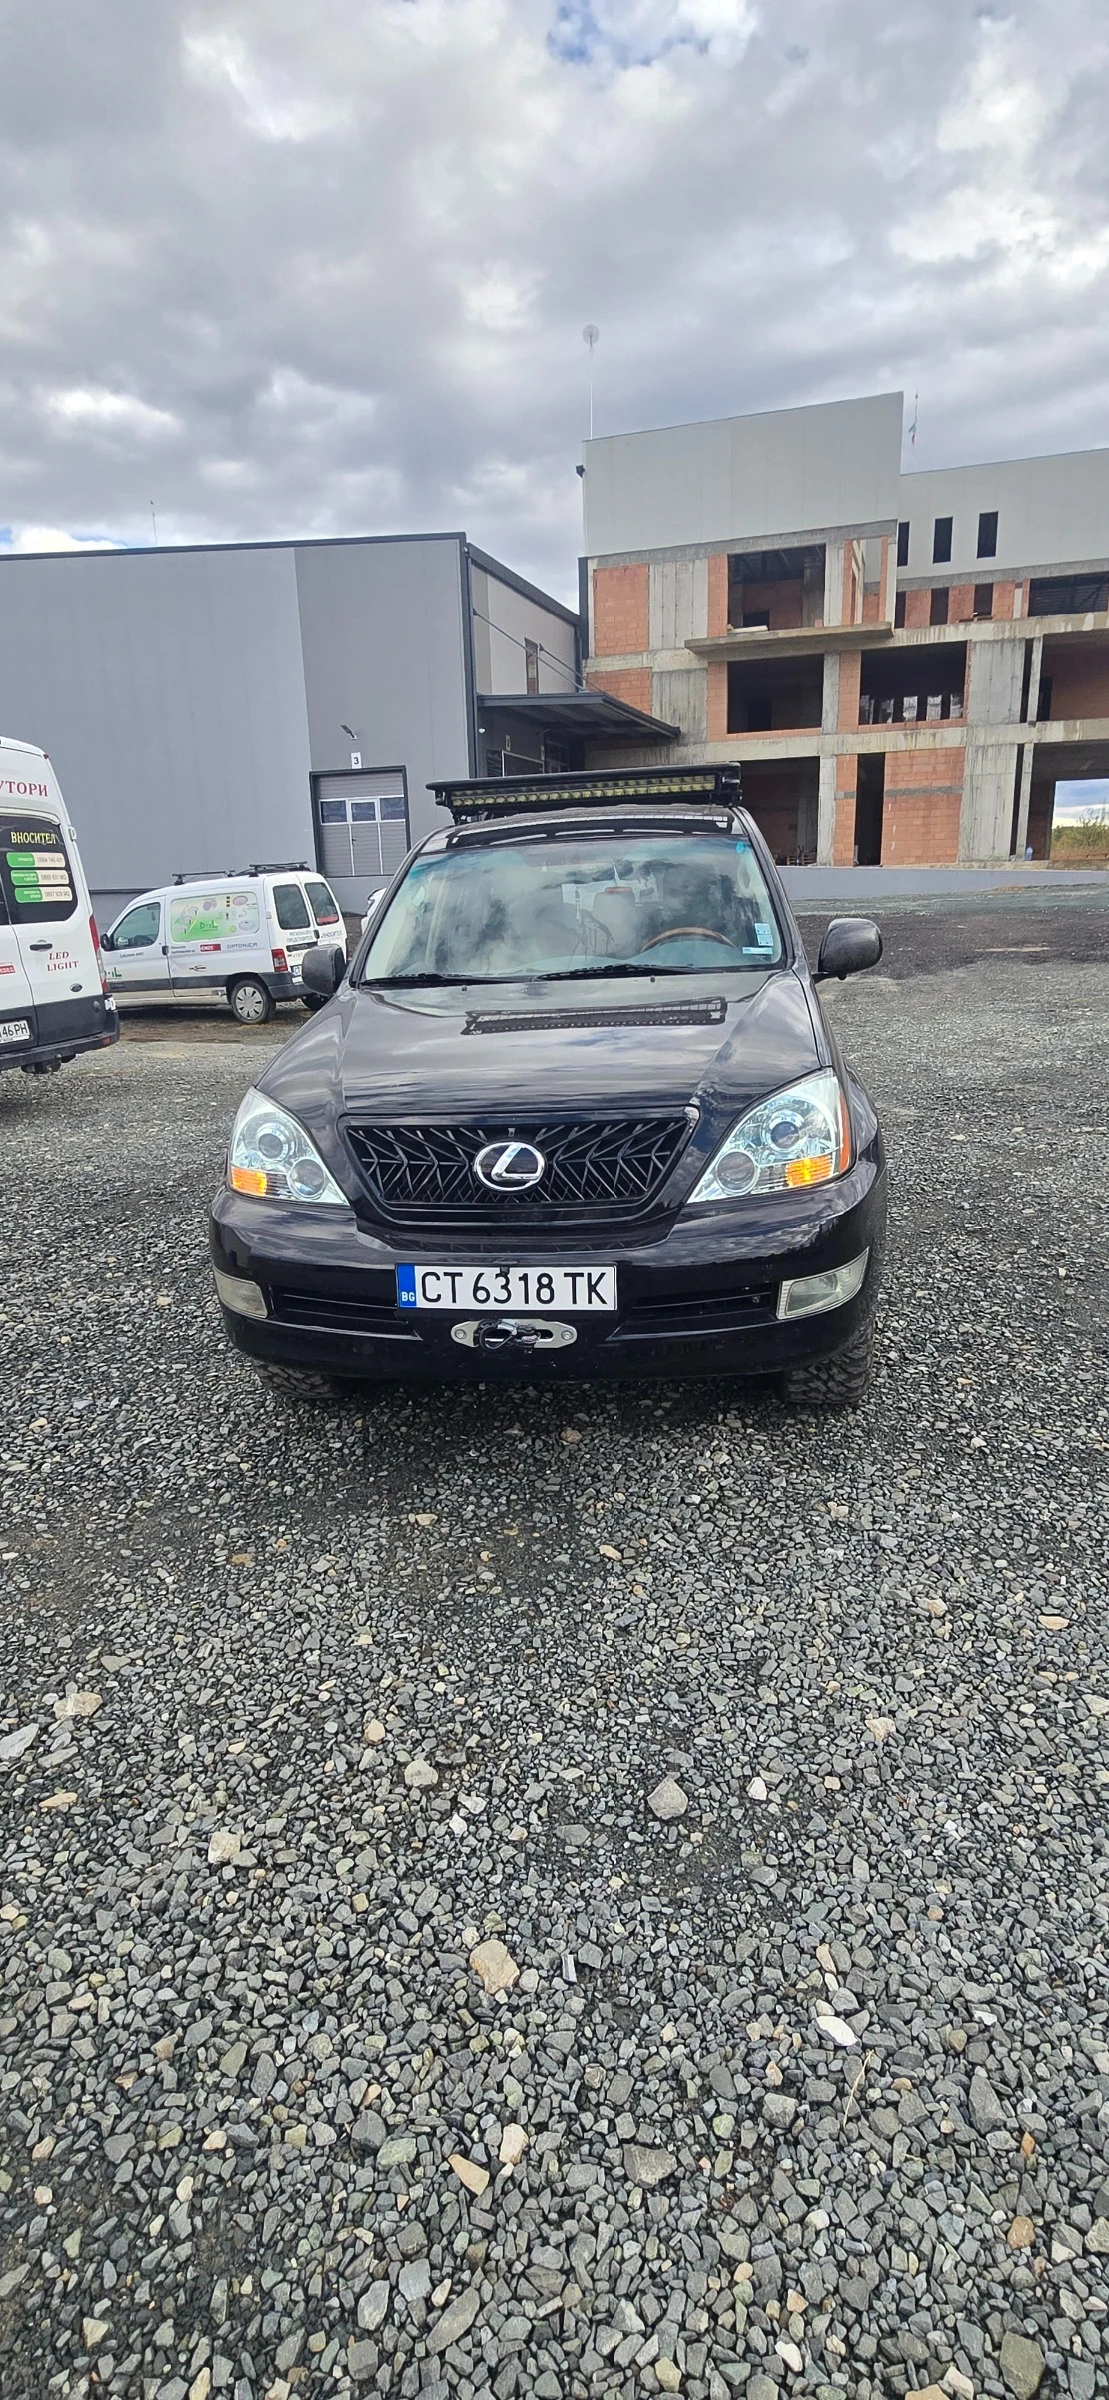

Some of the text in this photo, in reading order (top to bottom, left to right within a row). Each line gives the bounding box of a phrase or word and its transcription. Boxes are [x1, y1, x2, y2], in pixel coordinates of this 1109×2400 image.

[353, 756, 360, 765] 3
[11, 831, 56, 844] ВНОСИТЕЛ
[49, 951, 70, 961] LED
[47, 961, 79, 972] LIGHT
[401, 1271, 608, 1305] BG CT 6318 TK
